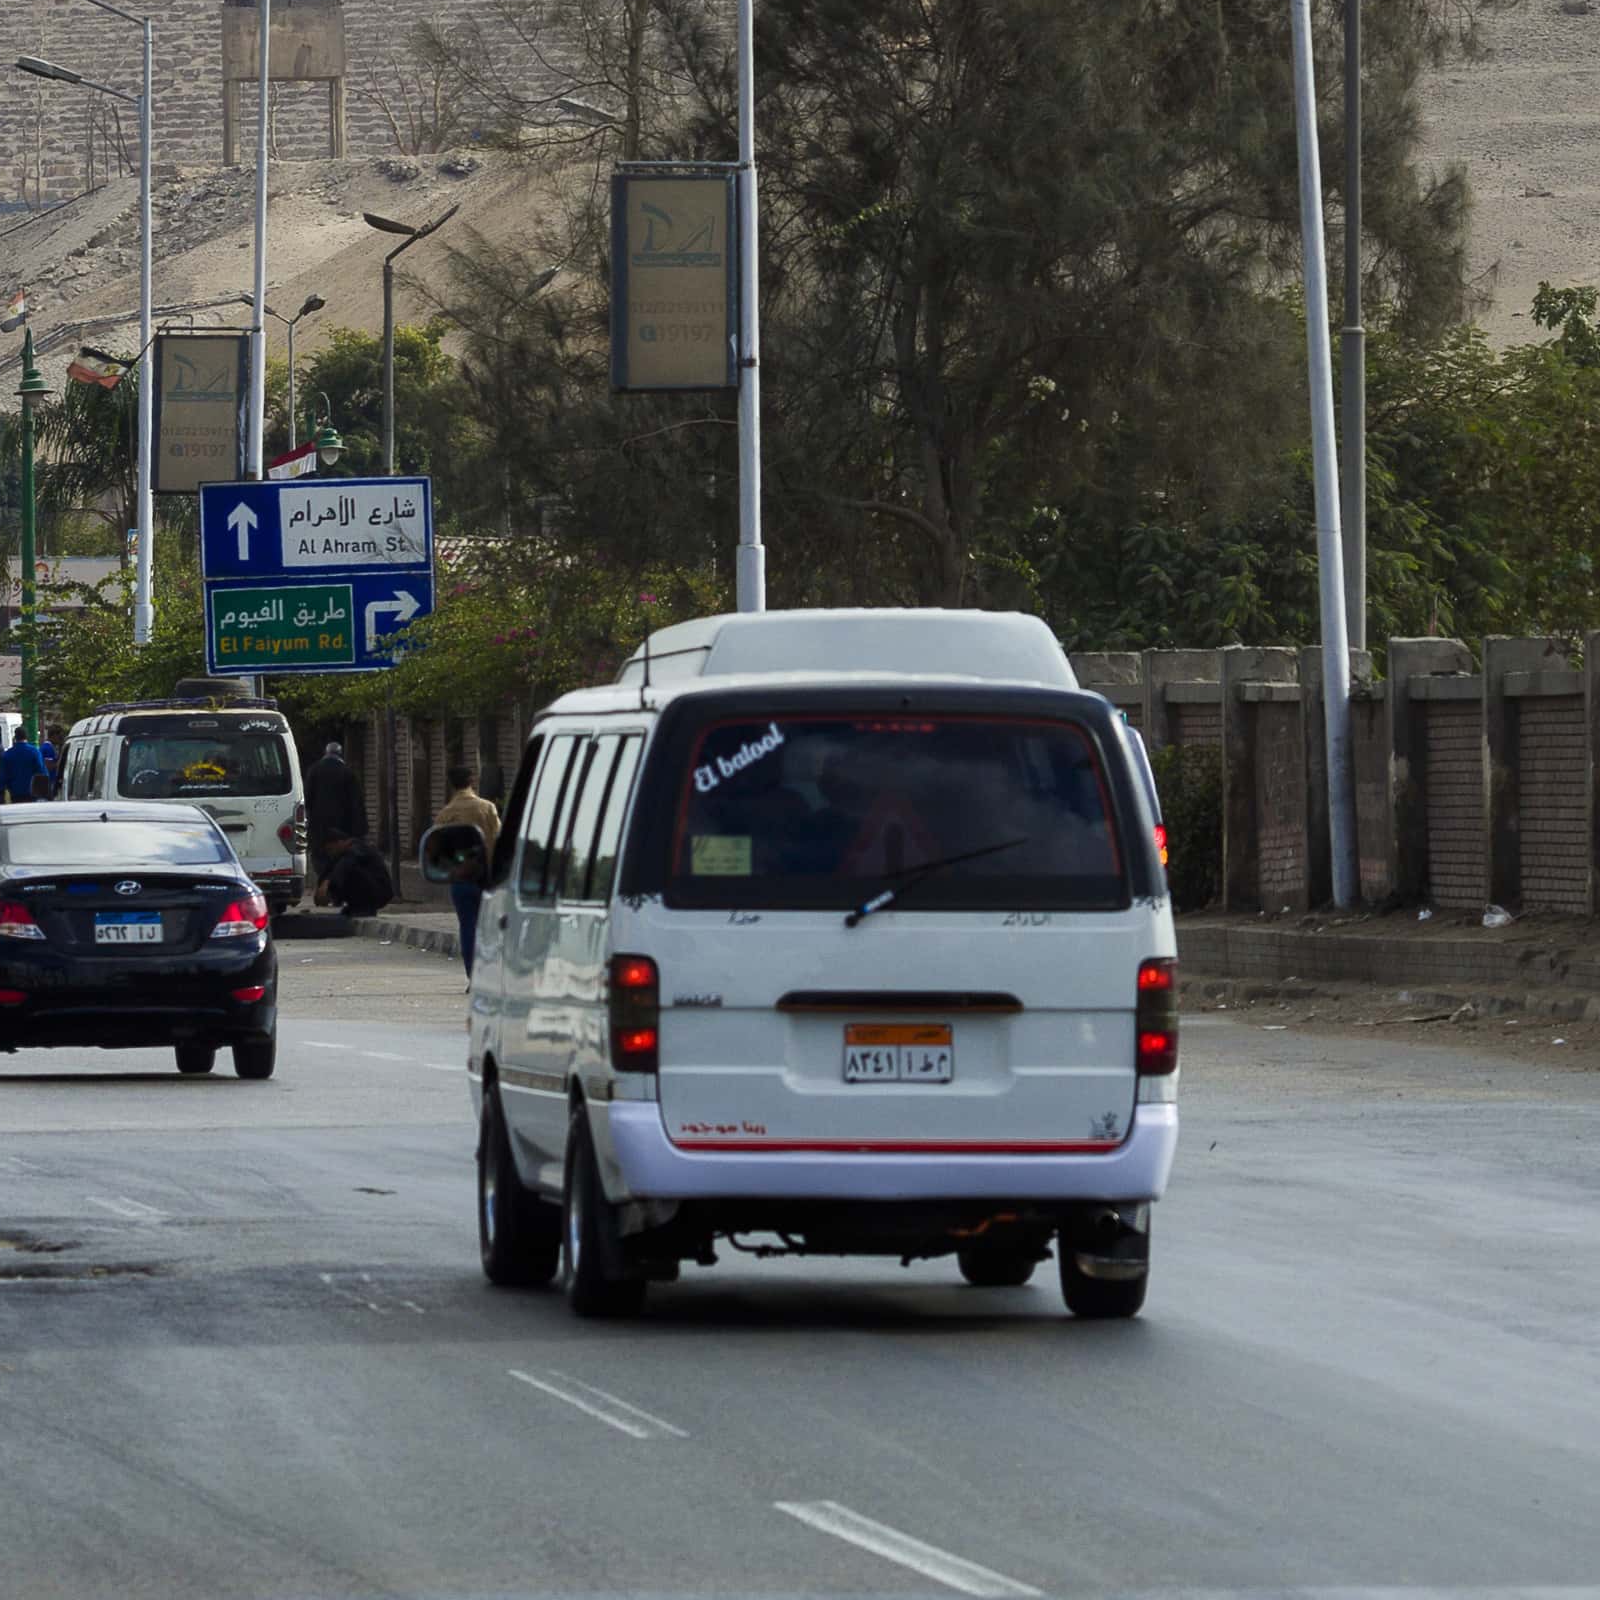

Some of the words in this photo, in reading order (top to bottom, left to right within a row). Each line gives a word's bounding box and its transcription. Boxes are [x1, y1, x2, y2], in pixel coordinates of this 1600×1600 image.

[368, 496, 416, 525] شارع
[298, 539, 317, 554] Al
[322, 538, 377, 554] Ahram
[220, 599, 284, 630] الفيوم
[293, 596, 346, 627] طريق
[220, 637, 239, 654] El
[243, 635, 310, 655] Faiyum
[318, 633, 348, 650] Rd.
[694, 764, 719, 792] El
